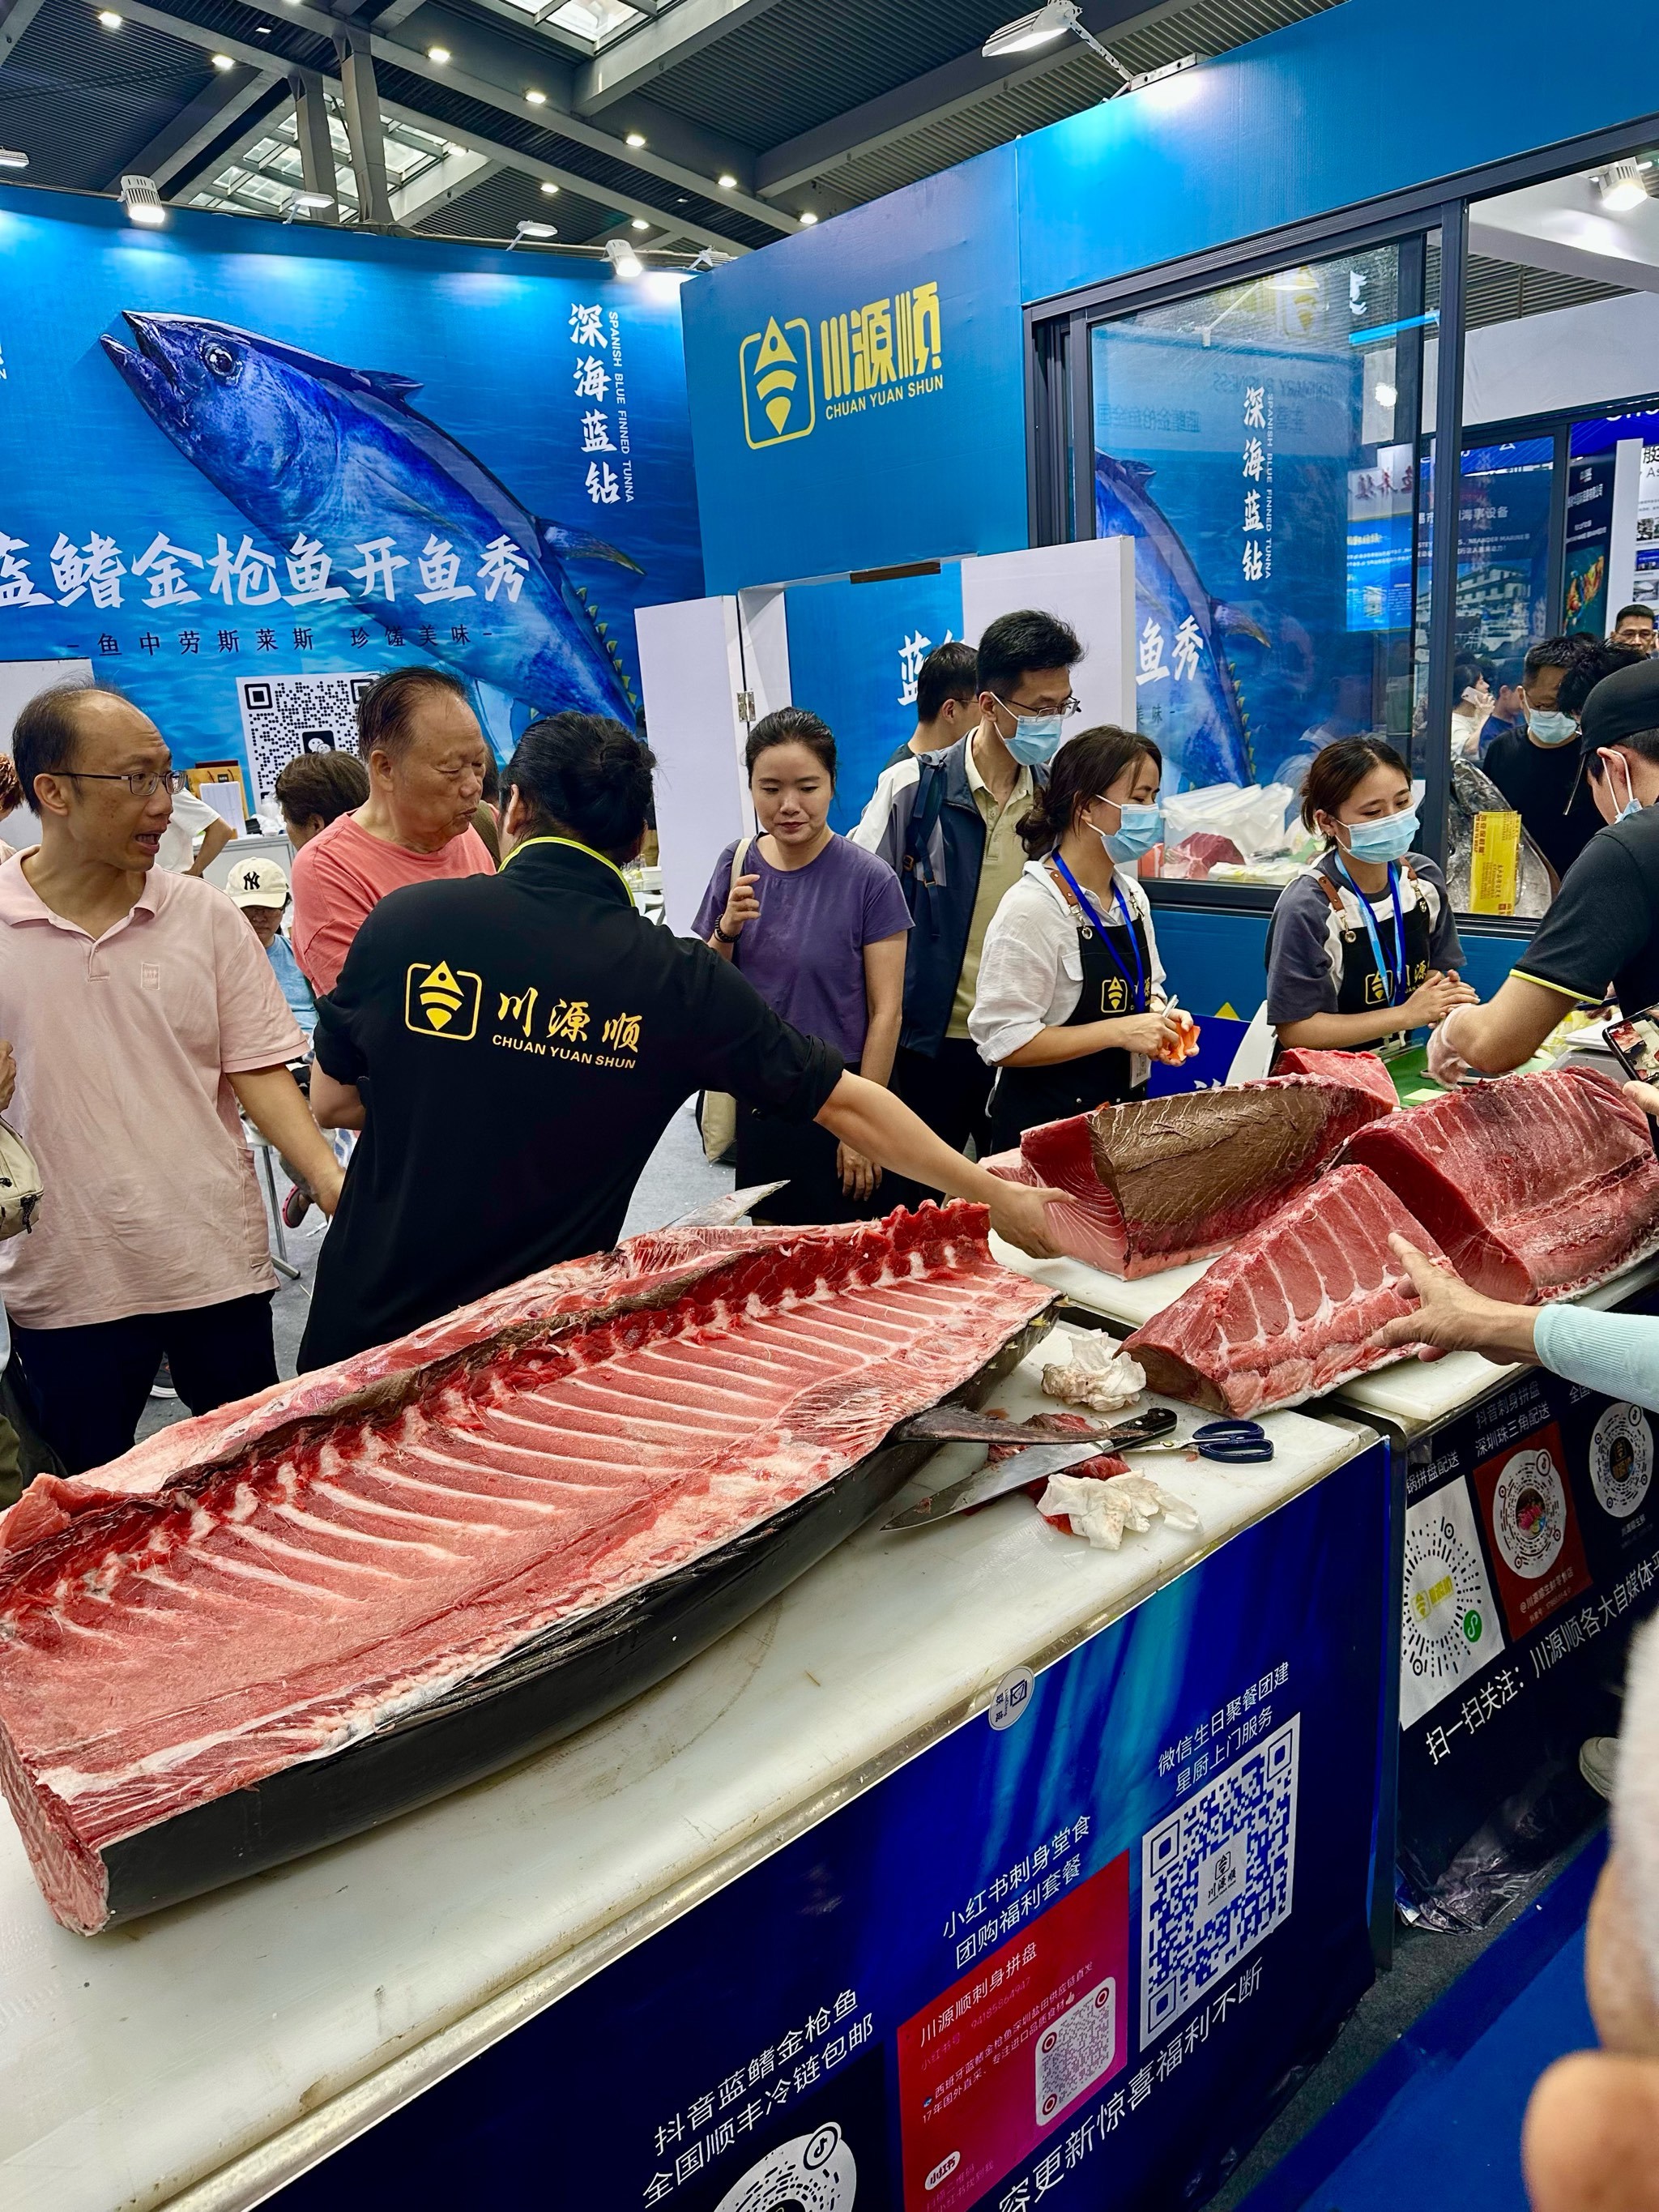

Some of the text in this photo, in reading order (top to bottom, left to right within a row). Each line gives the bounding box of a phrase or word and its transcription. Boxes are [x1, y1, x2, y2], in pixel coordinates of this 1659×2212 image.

[820, 280, 942, 401] 川源顺
[568, 302, 621, 504] 深海蓝钻
[608, 310, 634, 503] SPANISH BLUE FINNED TUNNA
[825, 374, 944, 421] CHUAN YUAN SHUN
[1266, 393, 1274, 447] SPANISH
[1242, 386, 1266, 582] 深海蓝钻
[1265, 489, 1273, 532] FINNED
[0, 530, 530, 609] 蓝鳍金枪鱼开鱼秀
[97, 627, 313, 656] 鱼中劳斯莱斯
[1136, 614, 1204, 685] 鱼秀
[243, 870, 261, 891] NY
[492, 1034, 636, 1069] CHUAN YUAN SHUN
[497, 987, 642, 1053] 川源顺
[1475, 1380, 1541, 1429] 抖音刺身拼盘
[1475, 1400, 1551, 1458] 深圳珠三角配送
[1158, 1661, 1290, 1778] 微信生日聚餐团建
[1175, 1705, 1273, 1797] 星厨上门服务
[943, 1815, 1090, 1939] 小红书刺身堂食
[956, 1853, 1081, 1970] 团购福利套餐
[920, 1941, 1038, 2048] 川源顺刺身拼盘
[642, 2012, 874, 2210] 全国顺丰冷链包邮
[654, 1988, 859, 2157] 抖音蓝鳍金枪鱼
[999, 1957, 1264, 2212] 容更新惊喜福利不断
[930, 2156, 956, 2185] 小红书
